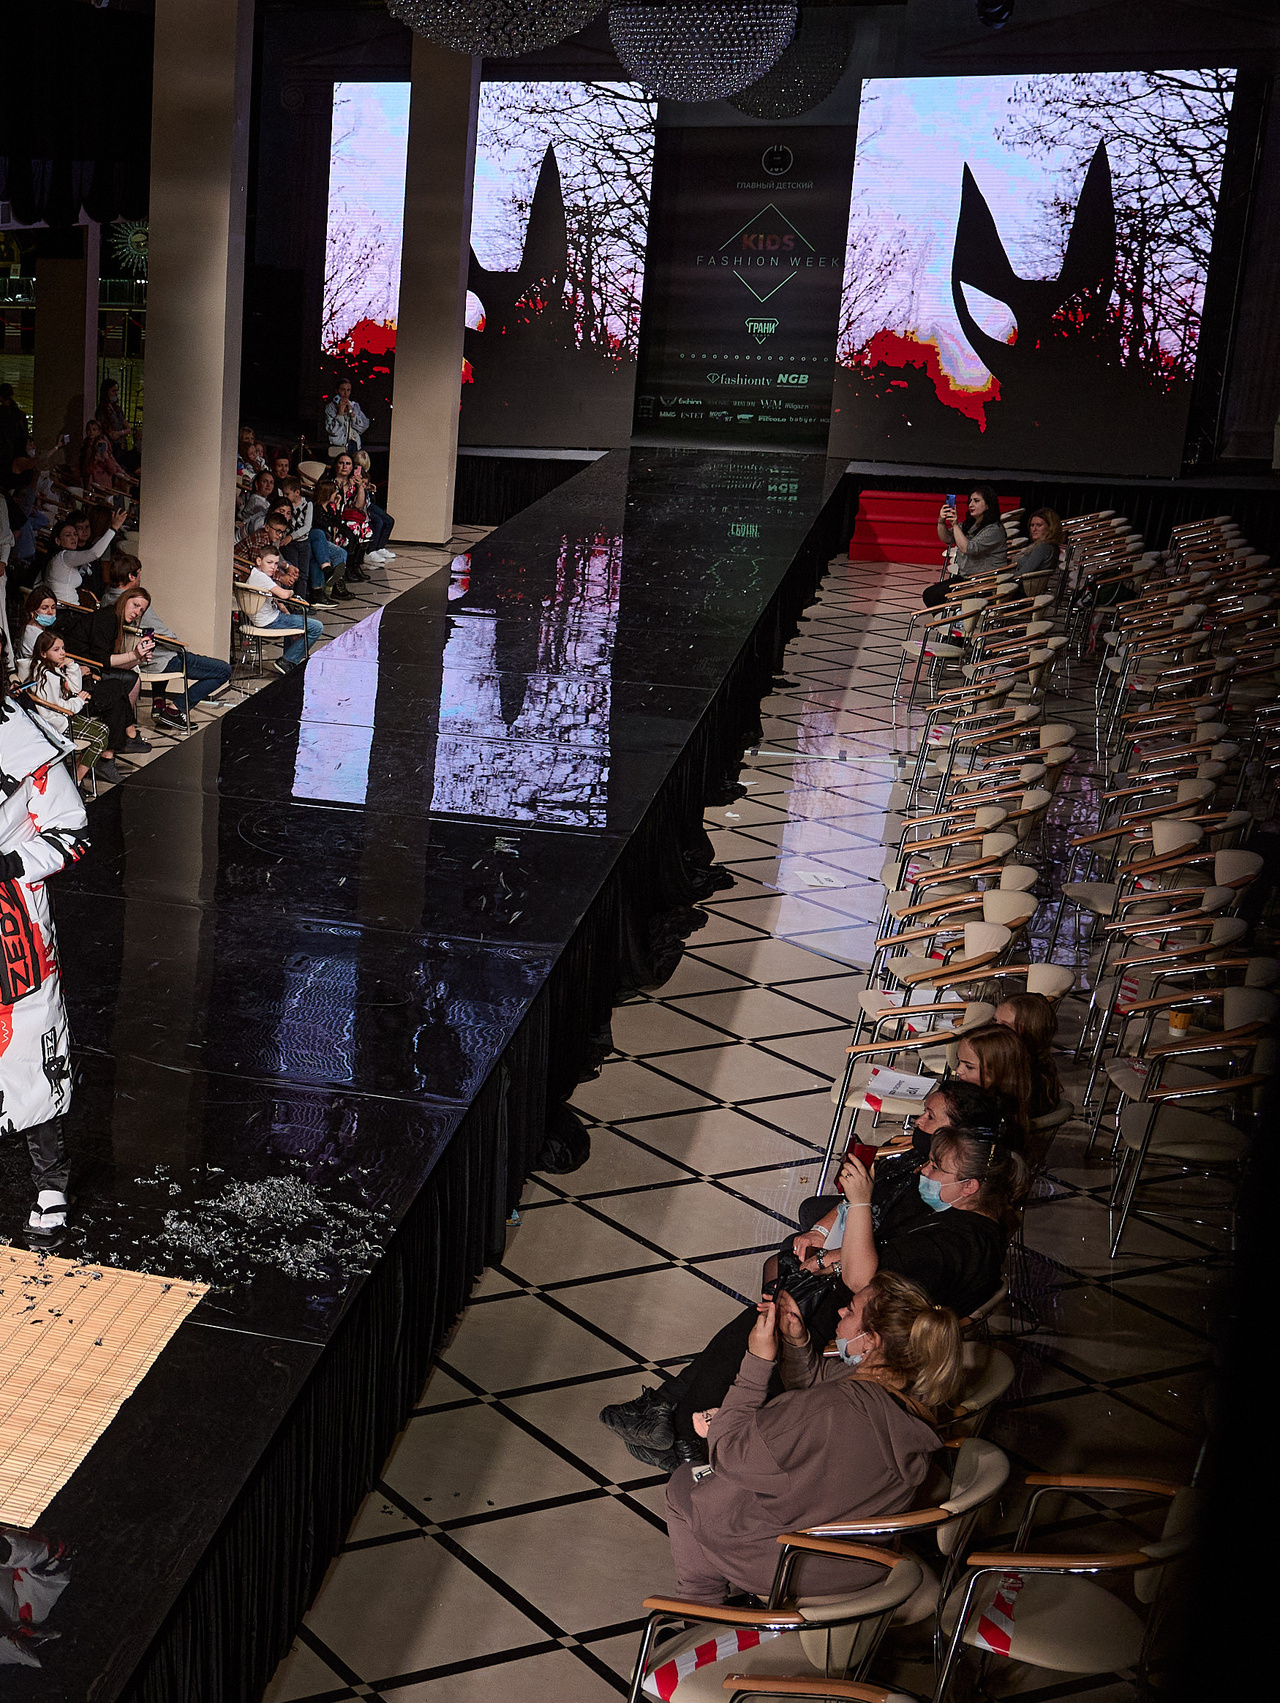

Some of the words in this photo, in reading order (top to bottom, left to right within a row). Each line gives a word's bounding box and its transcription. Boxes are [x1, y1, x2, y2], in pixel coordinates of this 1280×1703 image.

[736, 181, 775, 190] ГЛАВНЫЙ
[775, 181, 813, 190] ДЕТСКИЙ
[742, 234, 795, 251] KIDS
[696, 255, 779, 267] FASHION
[790, 256, 840, 268] WEEK
[748, 322, 776, 334] ГРАНИ
[720, 373, 772, 386] fashiontv
[777, 373, 809, 385] NGB
